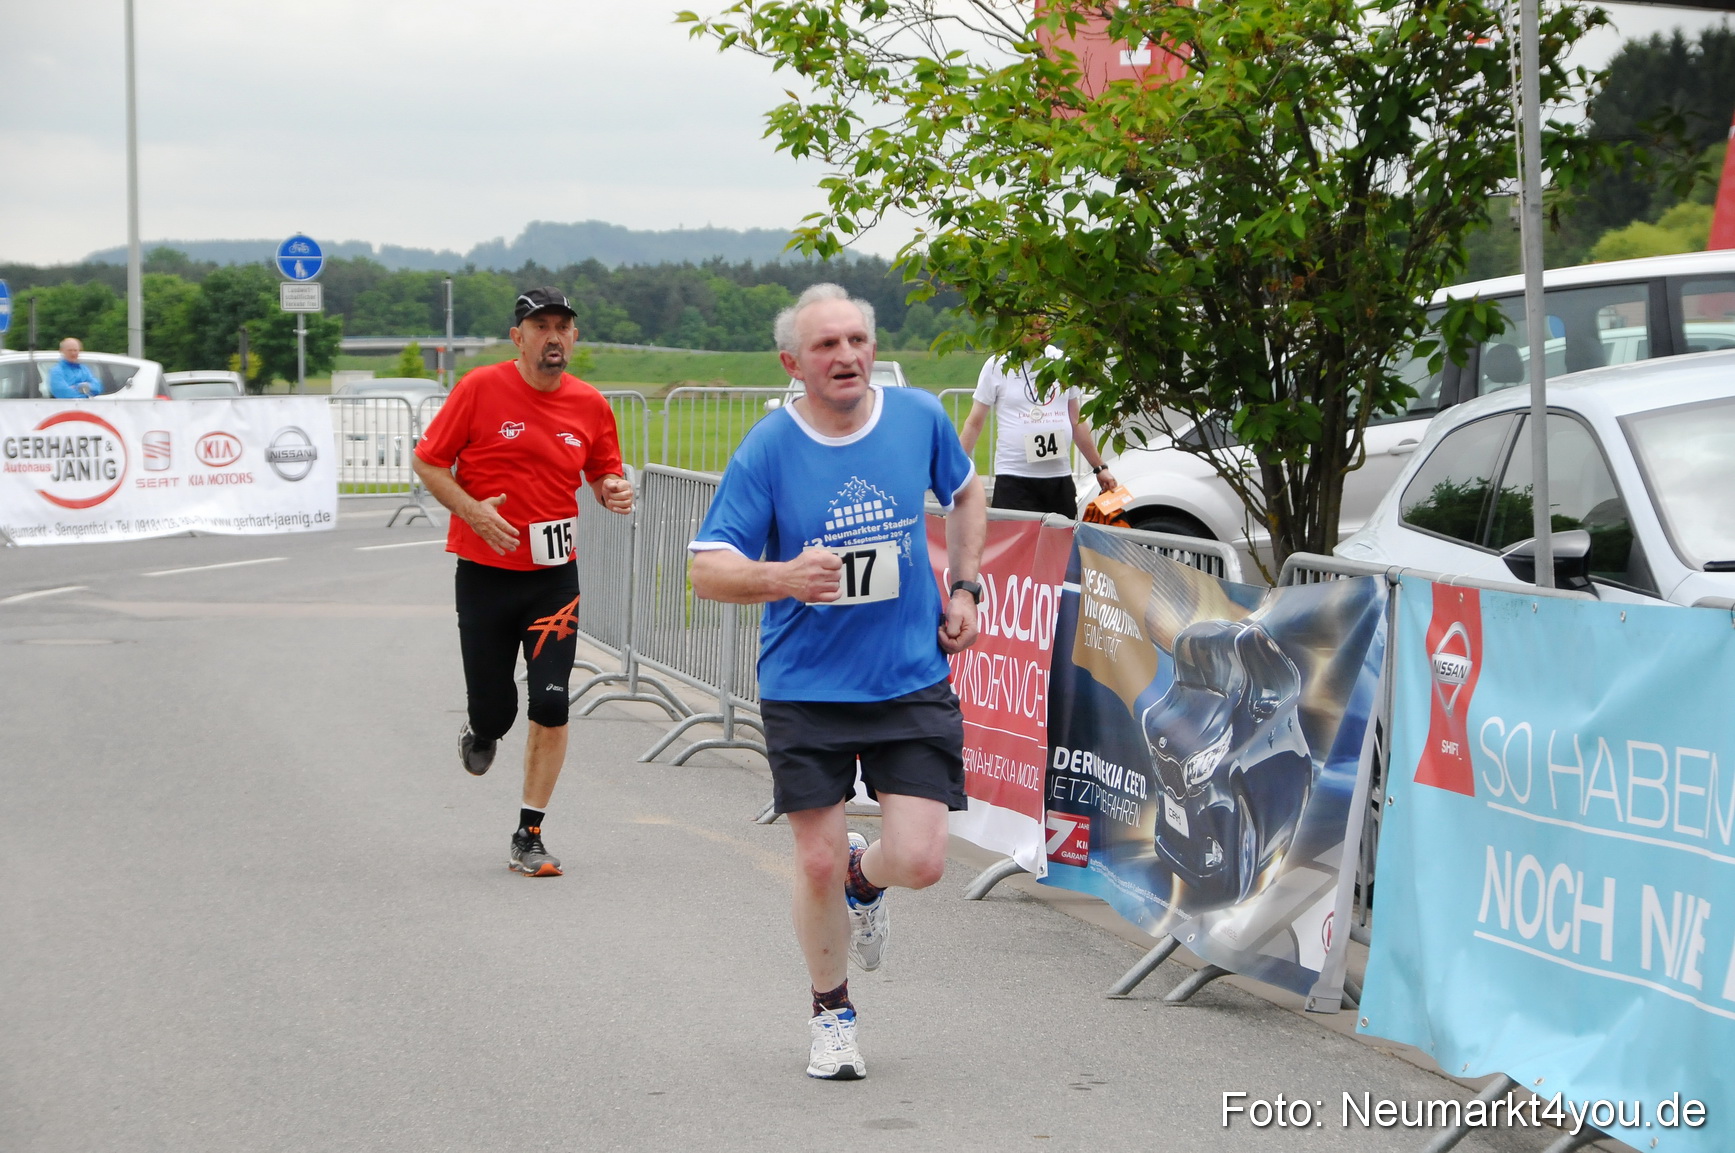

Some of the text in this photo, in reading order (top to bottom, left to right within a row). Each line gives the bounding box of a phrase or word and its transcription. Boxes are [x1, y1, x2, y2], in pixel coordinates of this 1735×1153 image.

[2, 435, 114, 459] GERHART &
[202, 440, 234, 459] KIA
[269, 449, 313, 460] NISSAN
[1034, 432, 1059, 458] 34
[3, 462, 52, 473] Autohaus
[50, 458, 117, 482] JÄNIG
[188, 472, 254, 487] KIA MOTORS
[135, 477, 180, 489] SEAT
[542, 522, 573, 560] 115
[823, 521, 882, 543] Neumarkter
[1433, 658, 1468, 679] NISSAN
[1053, 746, 1093, 775] DER
[1048, 774, 1096, 805] JETZT
[1479, 716, 1735, 846] SO HABEN
[1045, 816, 1078, 855] 7
[1477, 844, 1616, 962] NOCH
[1640, 883, 1712, 991] NIE
